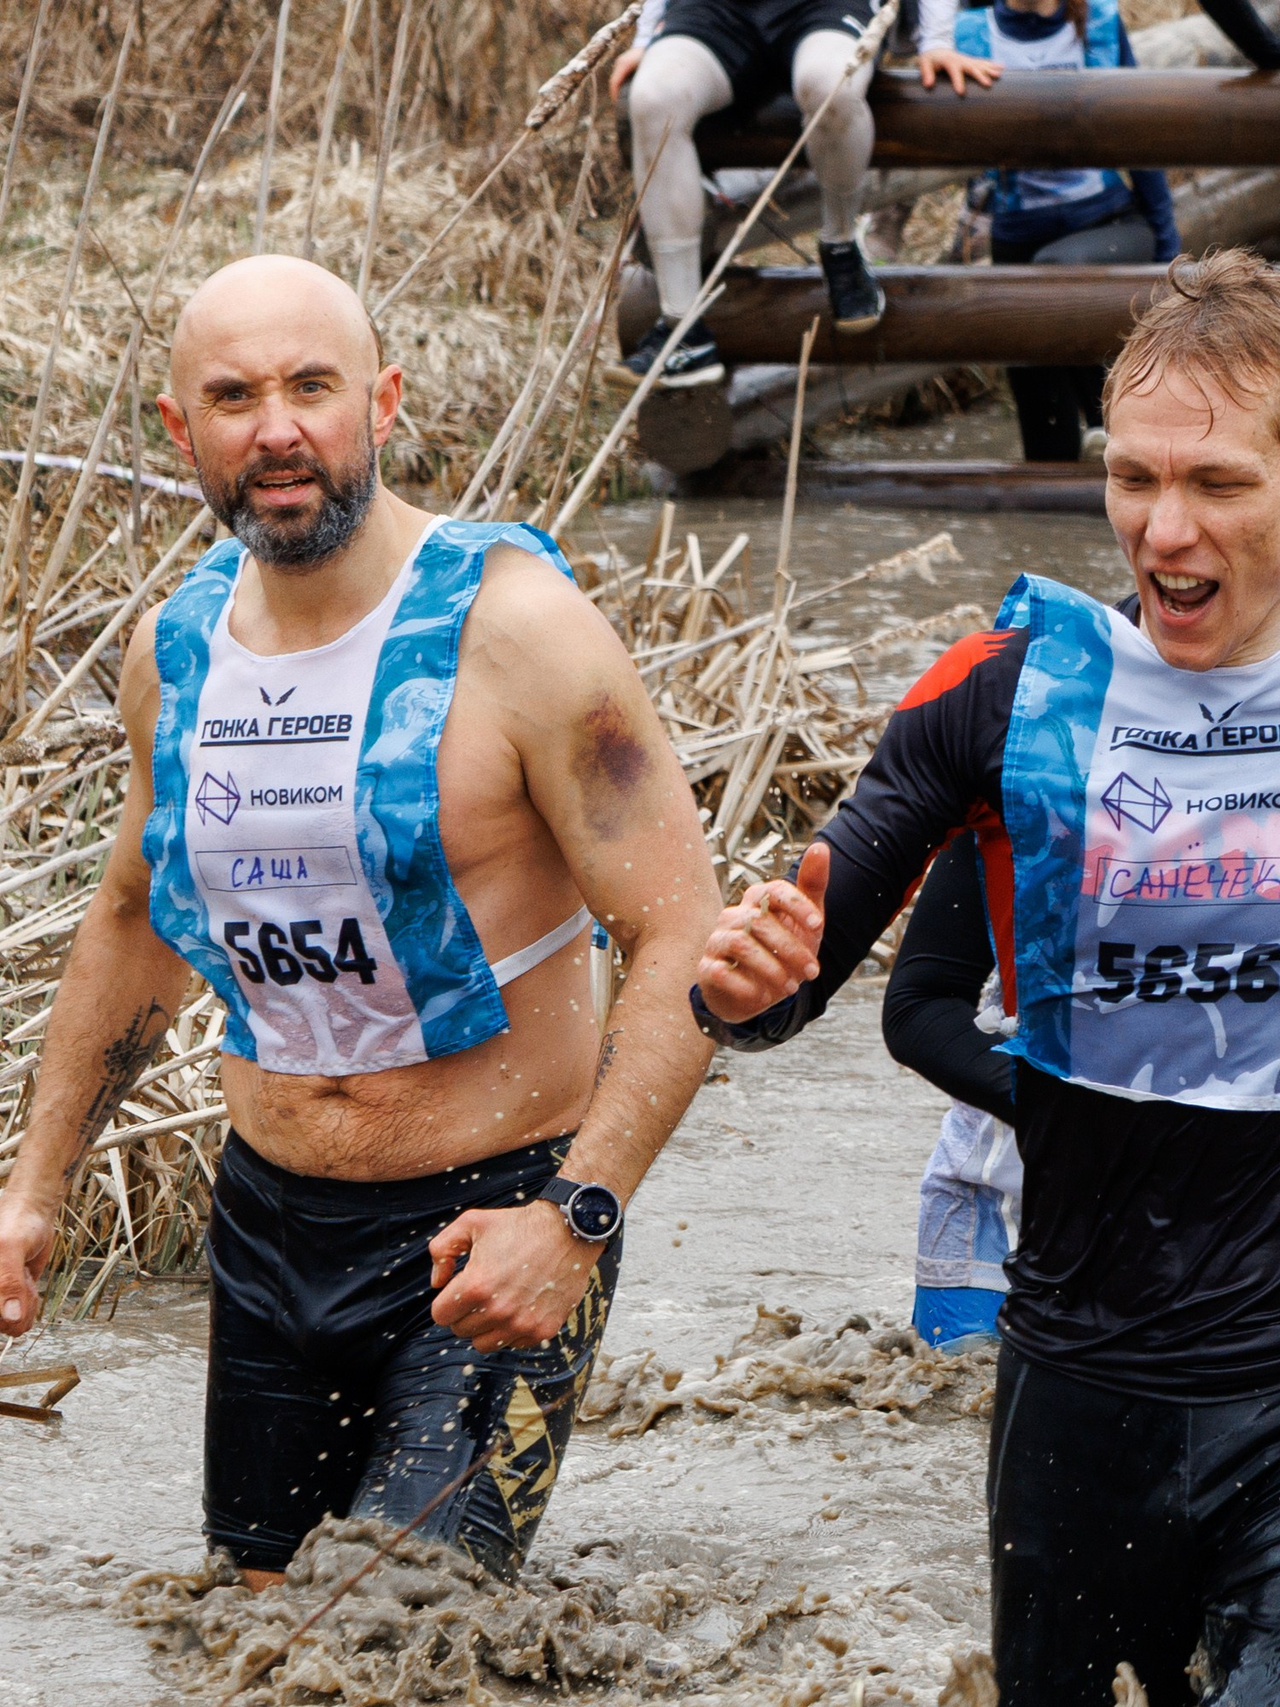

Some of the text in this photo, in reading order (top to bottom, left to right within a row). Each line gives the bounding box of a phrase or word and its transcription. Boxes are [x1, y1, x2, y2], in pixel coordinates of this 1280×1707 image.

[202, 714, 353, 740] ГОНКА ГЕРОЕВ
[1110, 725, 1199, 750] ГОНКА
[250, 785, 343, 806] НОВИКОМ
[231, 856, 309, 889] САША
[224, 917, 378, 987] 5654
